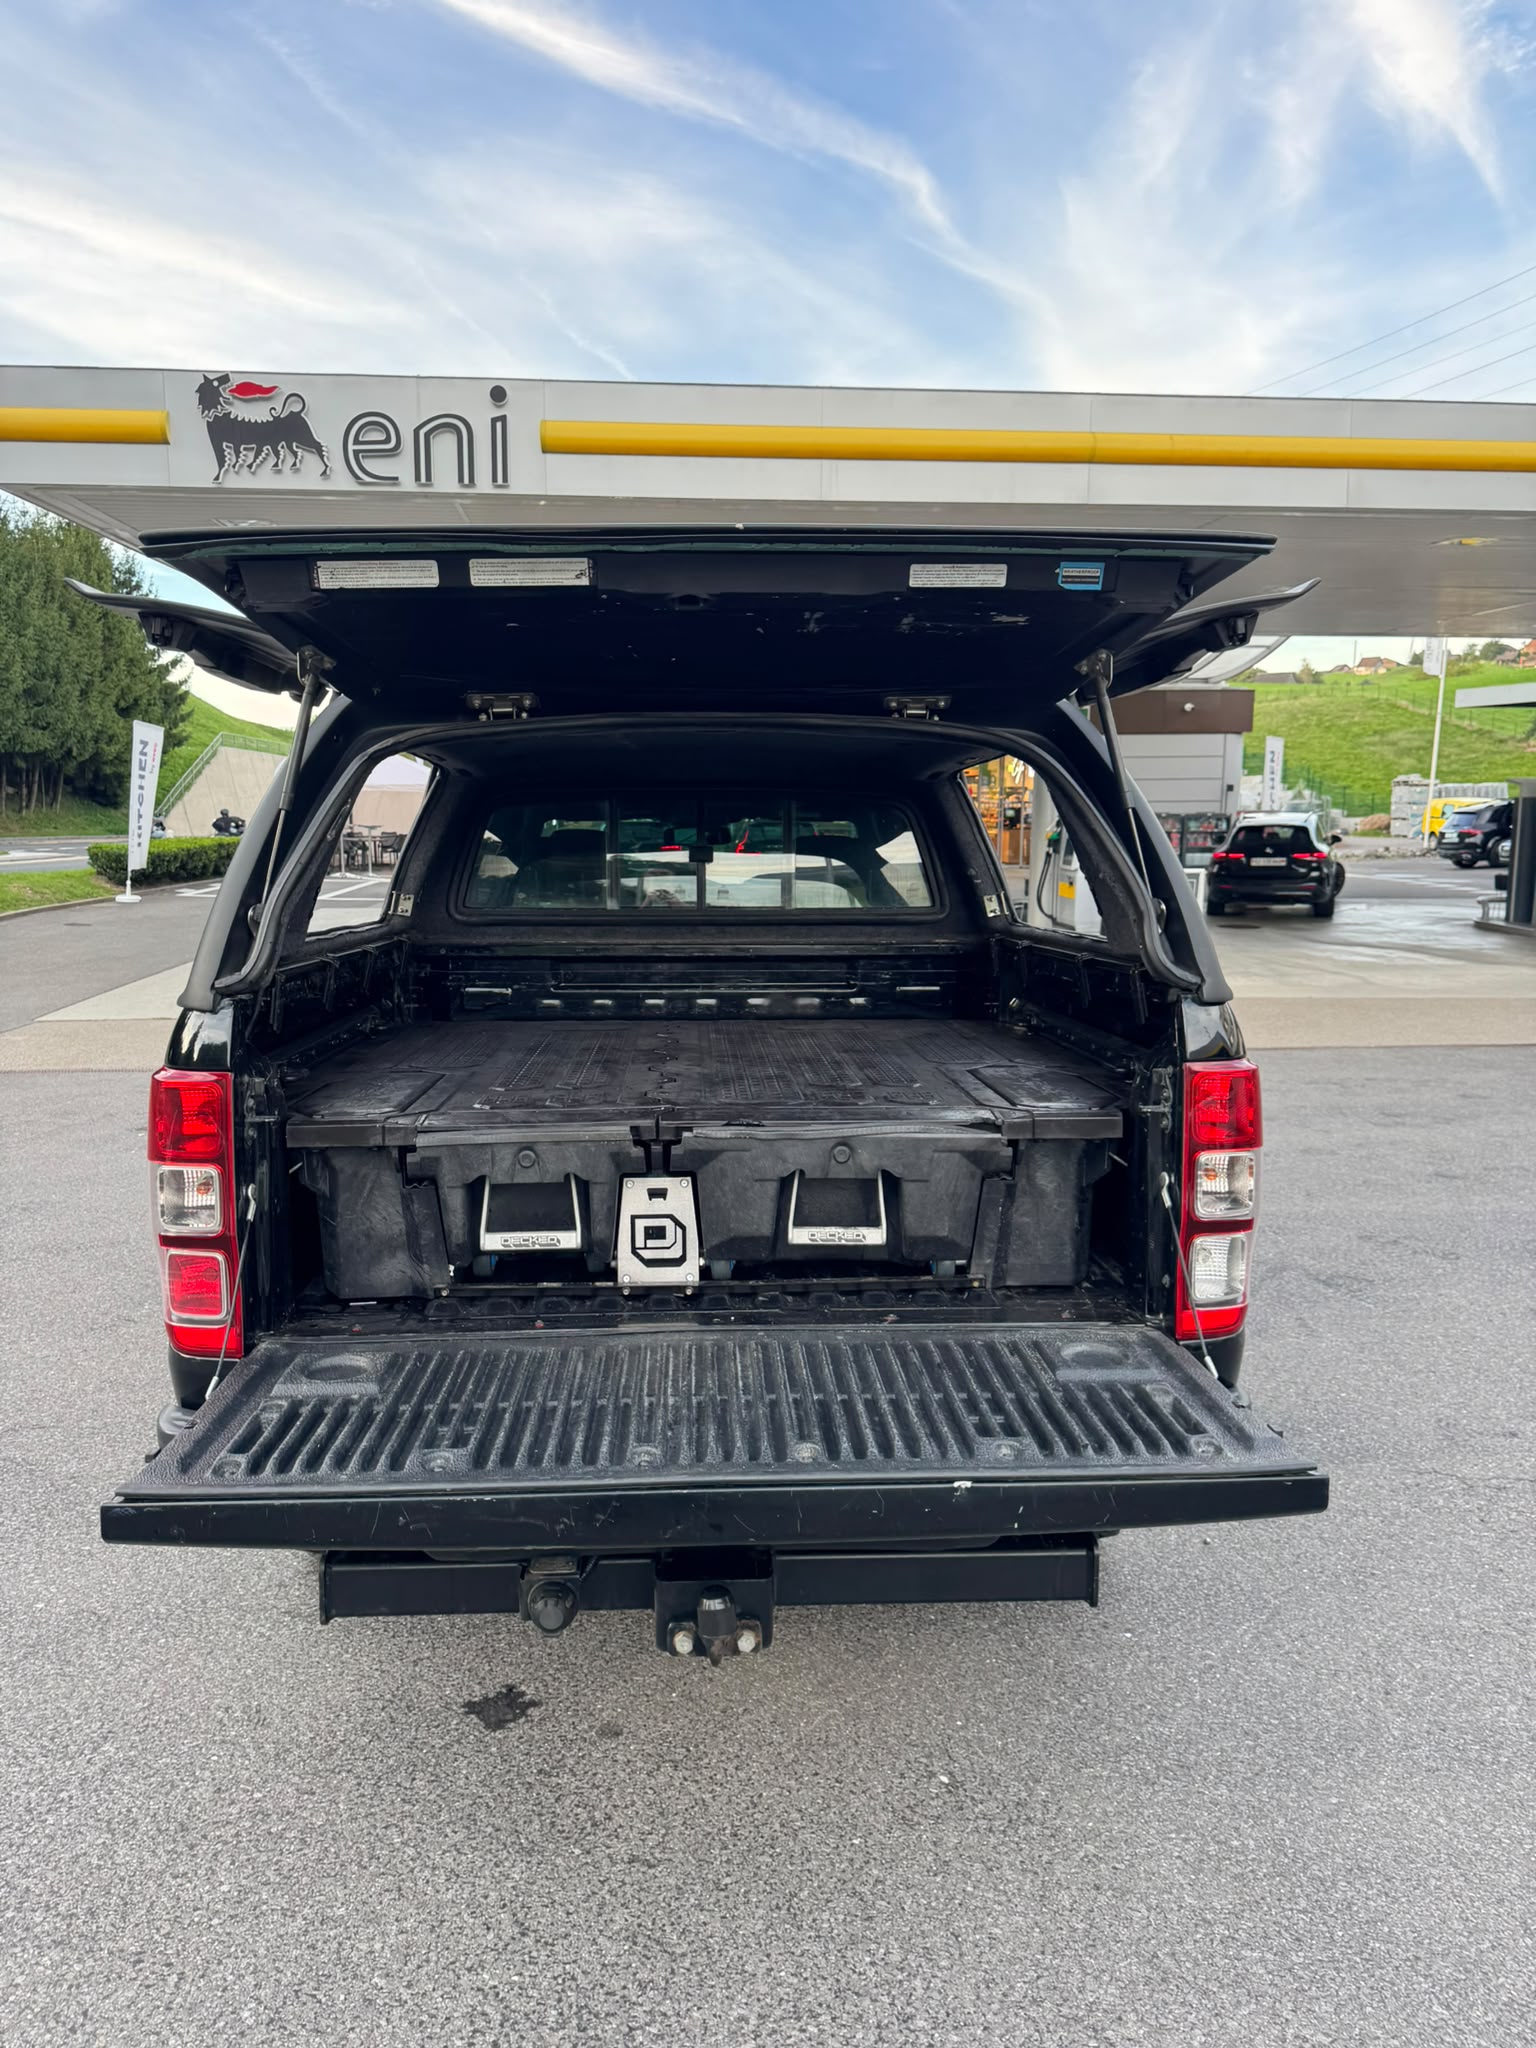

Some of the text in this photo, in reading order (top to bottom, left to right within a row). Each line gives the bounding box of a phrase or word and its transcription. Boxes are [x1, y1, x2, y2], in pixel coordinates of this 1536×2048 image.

[343, 384, 510, 485] eni
[137, 740, 149, 847] KITCHEN
[500, 1235, 561, 1248] DECKED
[808, 1231, 867, 1243] DECKED
